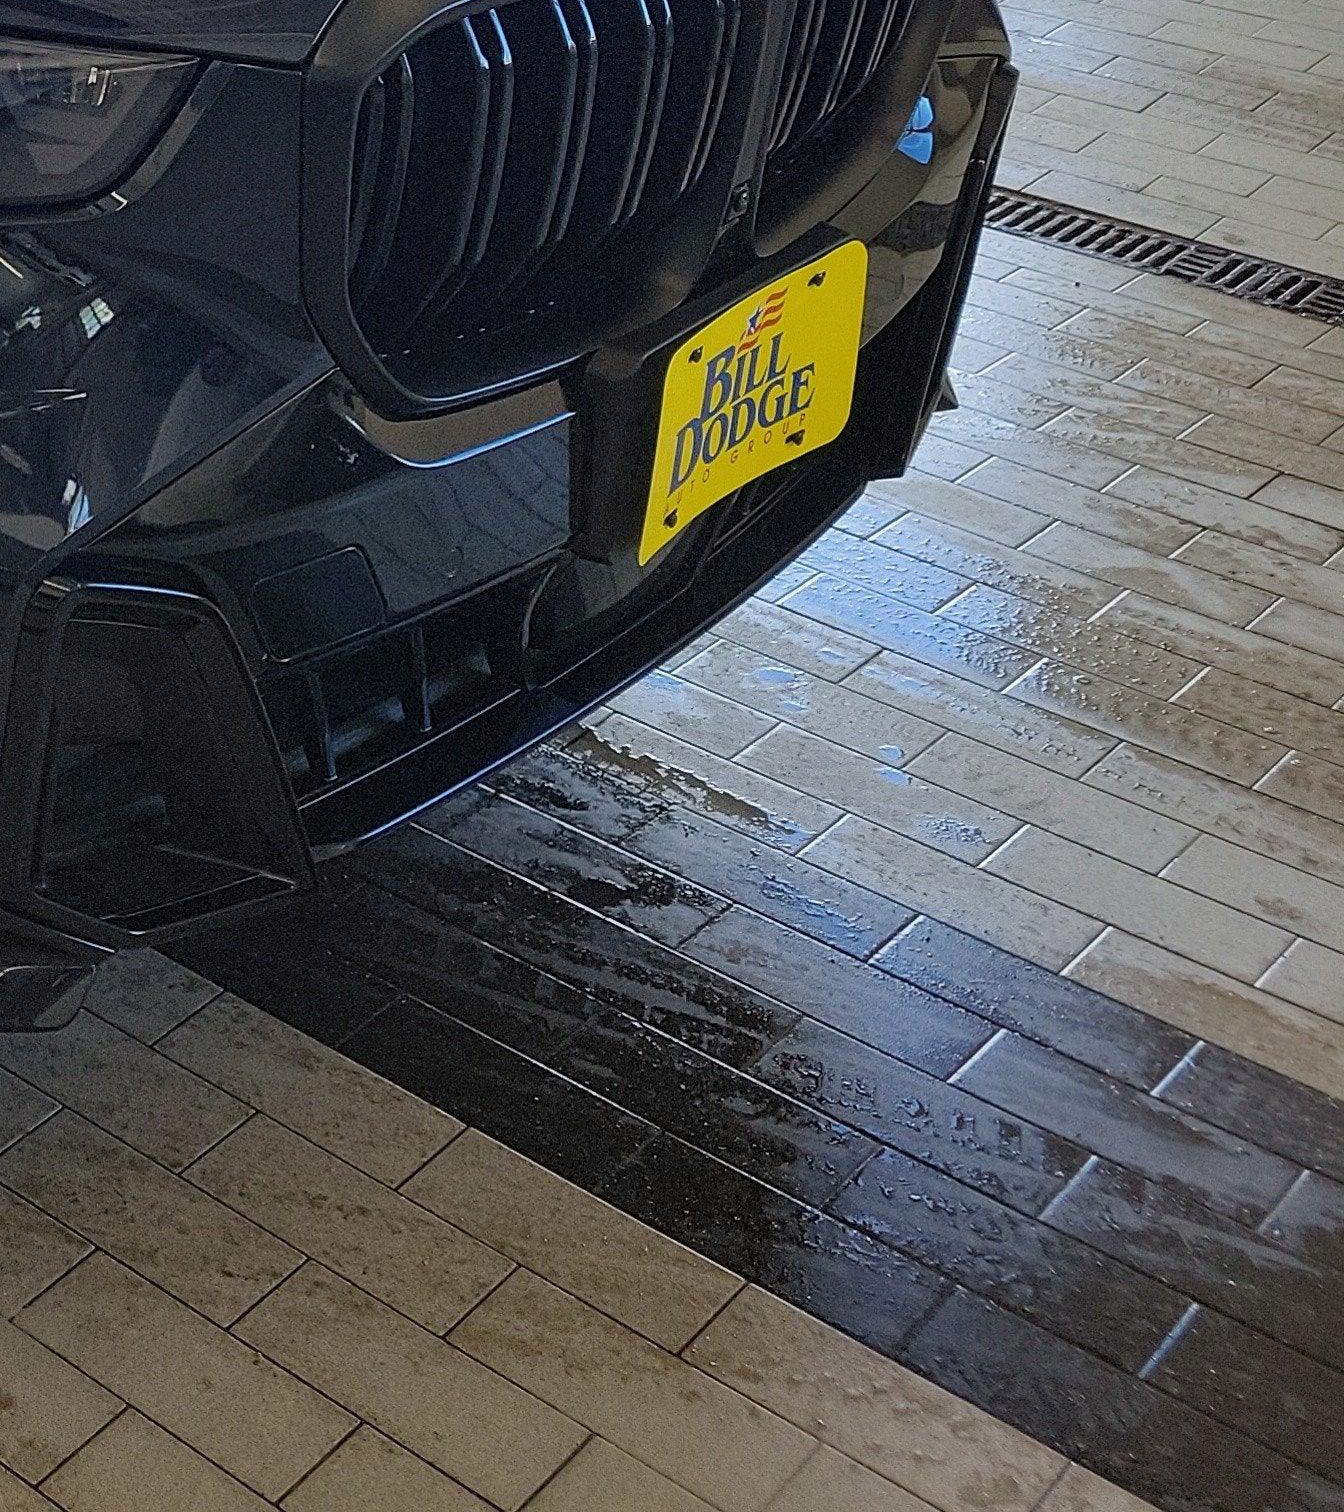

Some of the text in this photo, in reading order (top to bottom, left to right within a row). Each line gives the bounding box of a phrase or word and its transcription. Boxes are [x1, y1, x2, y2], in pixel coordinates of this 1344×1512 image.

[700, 331, 792, 422] BILL
[667, 361, 816, 498] DODGE
[730, 412, 807, 464] GROUP
